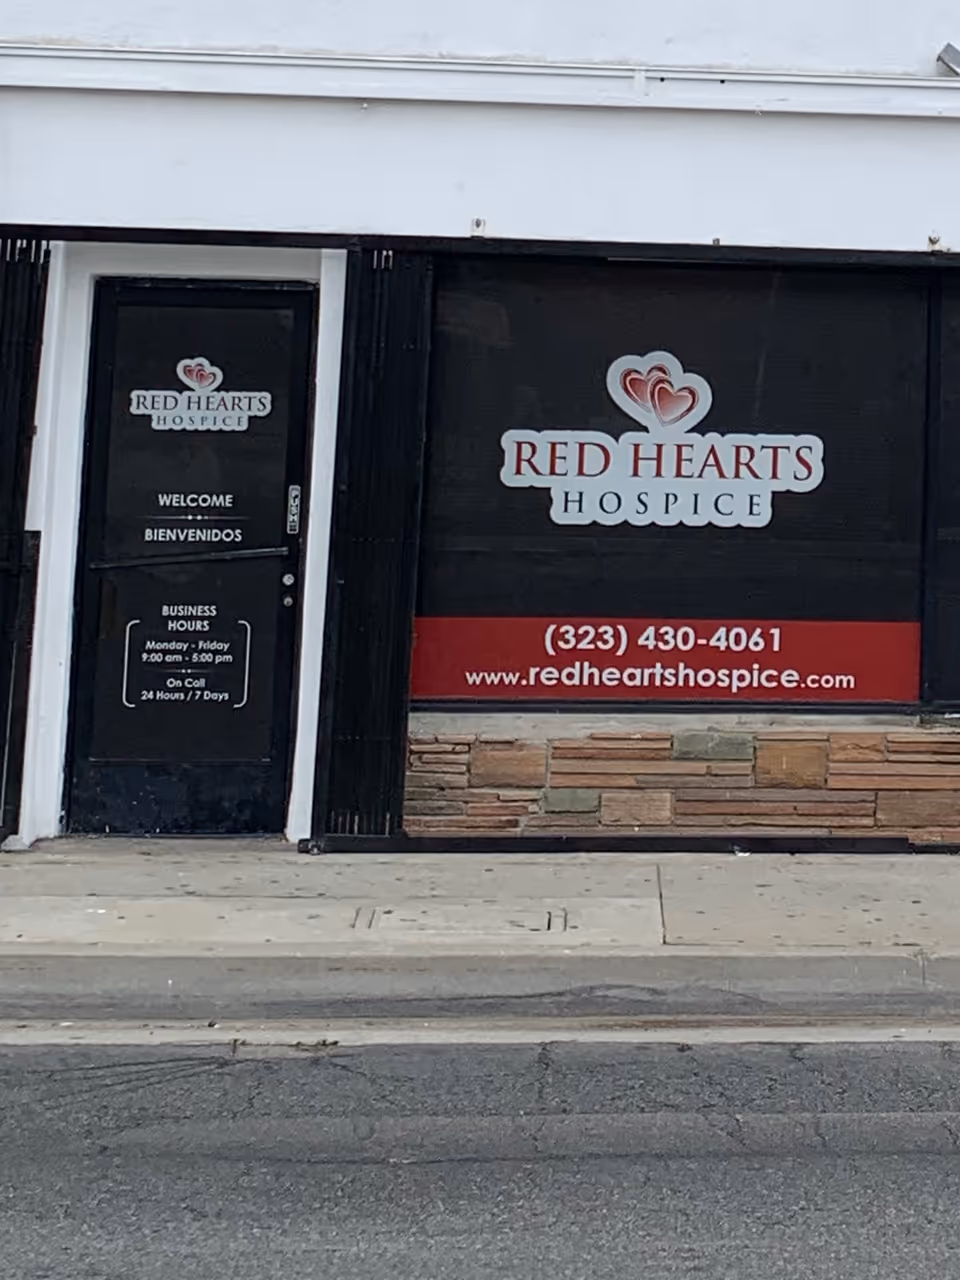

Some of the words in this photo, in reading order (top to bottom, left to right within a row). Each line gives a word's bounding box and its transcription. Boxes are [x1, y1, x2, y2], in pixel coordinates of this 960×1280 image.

[135, 394, 179, 411] RED
[187, 395, 268, 412] HEARTS
[156, 415, 244, 427] HOSPICE
[512, 440, 612, 478] RED
[631, 443, 815, 482] HEARTS
[158, 493, 234, 508] WELCOME
[561, 491, 763, 517] HOSPICE
[144, 528, 243, 542] BIENVENIDOS
[161, 605, 217, 616] BUSINESS
[167, 620, 210, 631] HOURS
[145, 640, 189, 652] Monday
[198, 640, 231, 652] Friday
[544, 623, 628, 656] (323)
[637, 625, 782, 651] 430-4061
[141, 652, 163, 662] 9:00
[165, 654, 183, 662] am
[191, 652, 214, 662] 5:00
[215, 654, 233, 664] pm
[166, 678, 182, 688] On
[184, 678, 206, 688] Call
[465, 662, 856, 693] www.redheartshospice.com
[141, 690, 154, 700] 24
[156, 690, 185, 700] Hours
[195, 690, 202, 700] 7
[203, 690, 229, 702] Days
